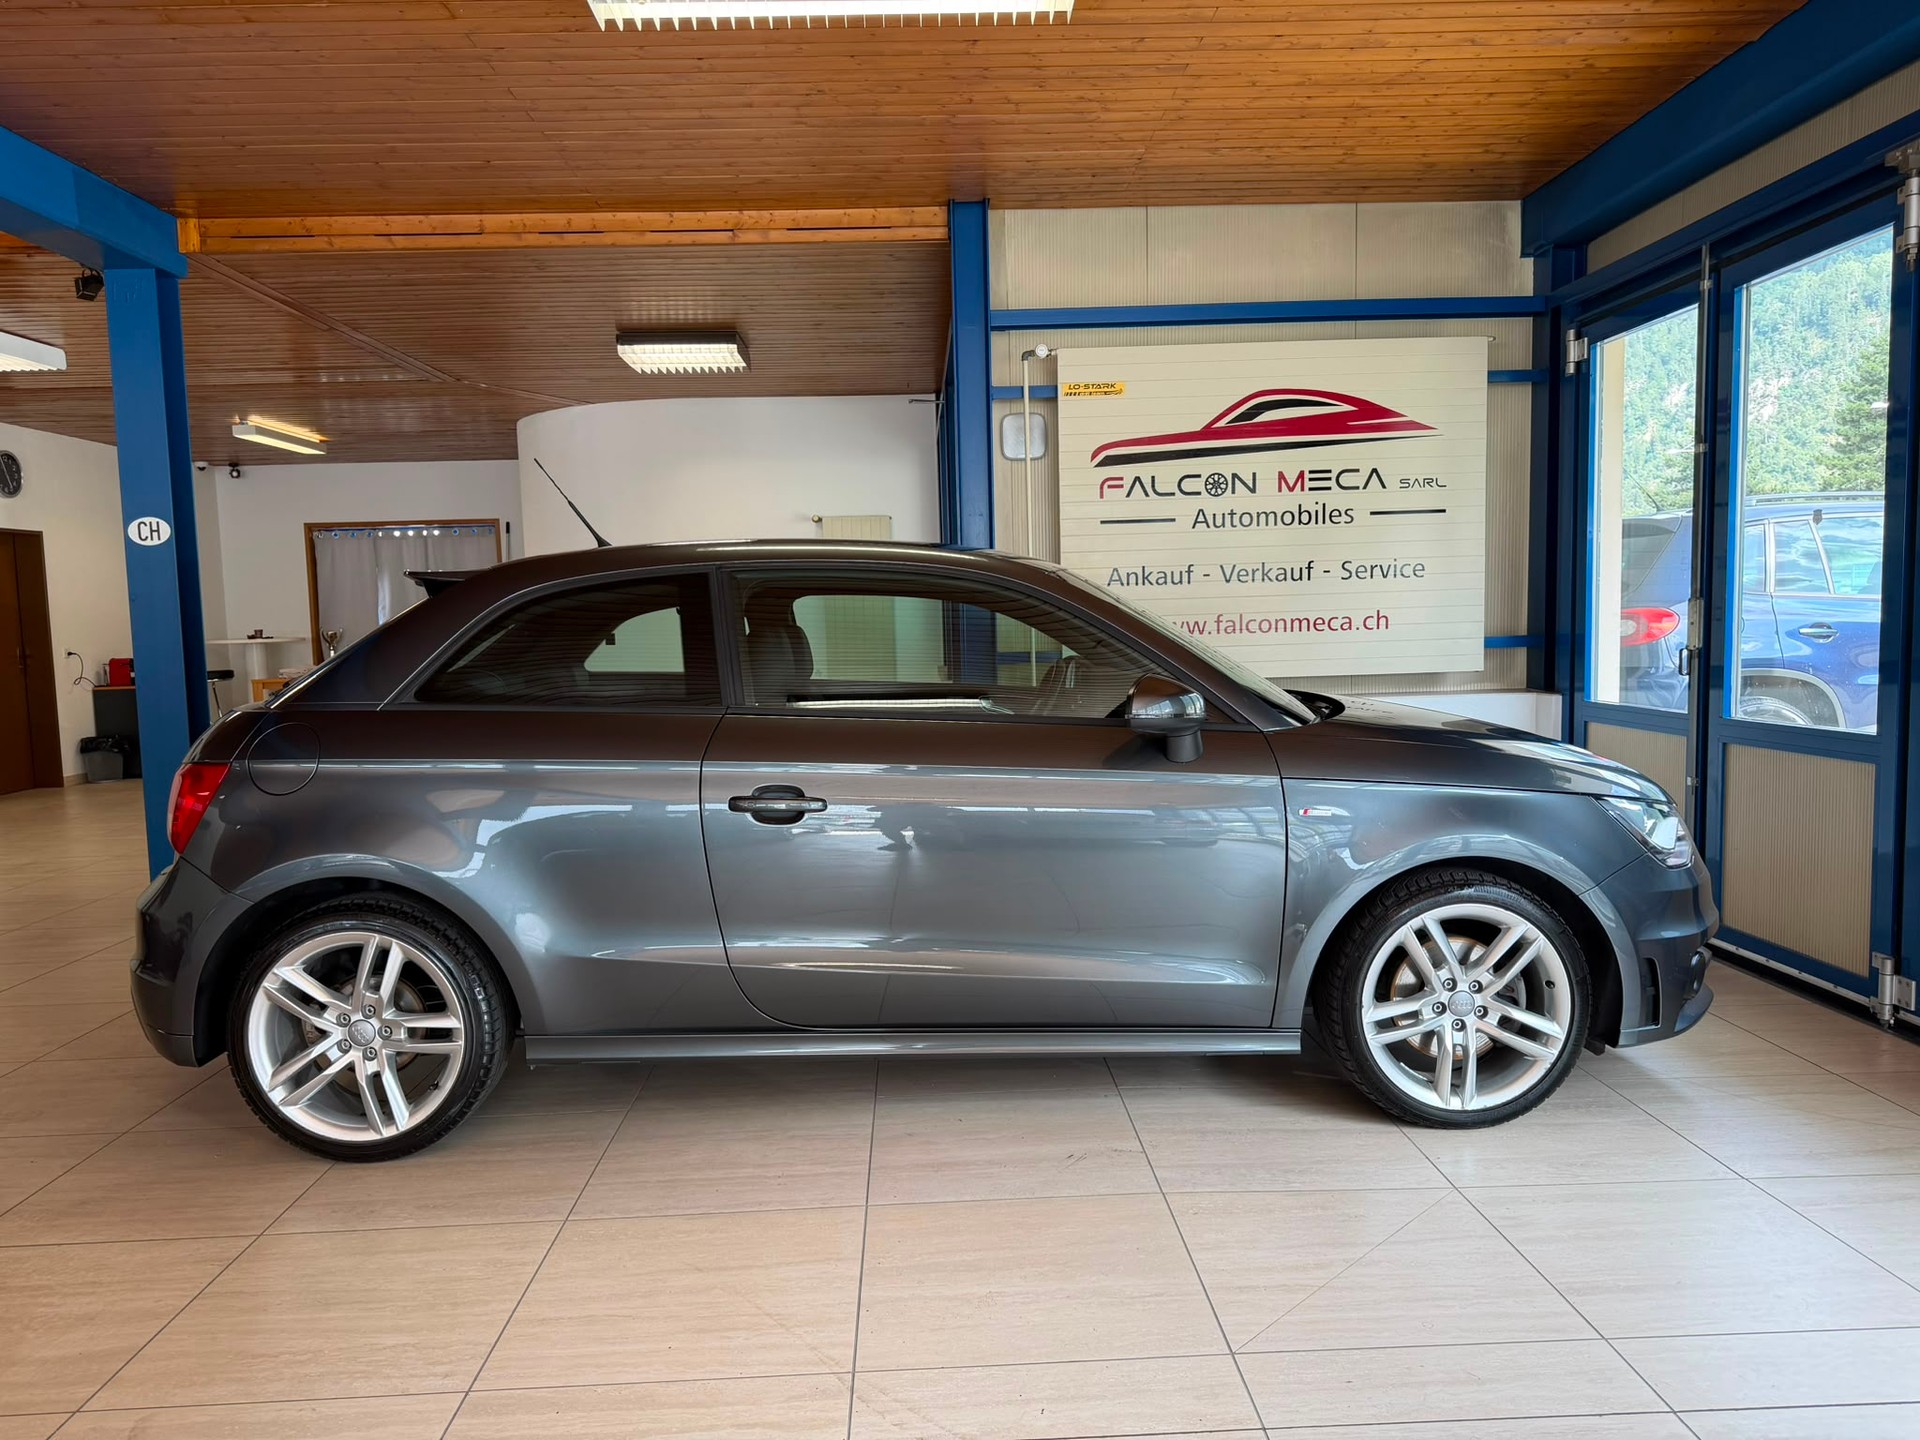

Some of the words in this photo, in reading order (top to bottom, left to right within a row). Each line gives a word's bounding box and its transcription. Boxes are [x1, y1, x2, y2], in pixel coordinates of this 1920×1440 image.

[1068, 383, 1117, 391] LO-STARK
[1099, 472, 1257, 499] FALCON
[1277, 467, 1387, 493] MECA
[1399, 477, 1447, 489] SARL
[1191, 501, 1355, 530] Automobiles
[137, 521, 161, 541] CH
[1106, 563, 1195, 587] Ankauf
[1219, 560, 1315, 584] Verkauf
[1340, 558, 1426, 581] Service
